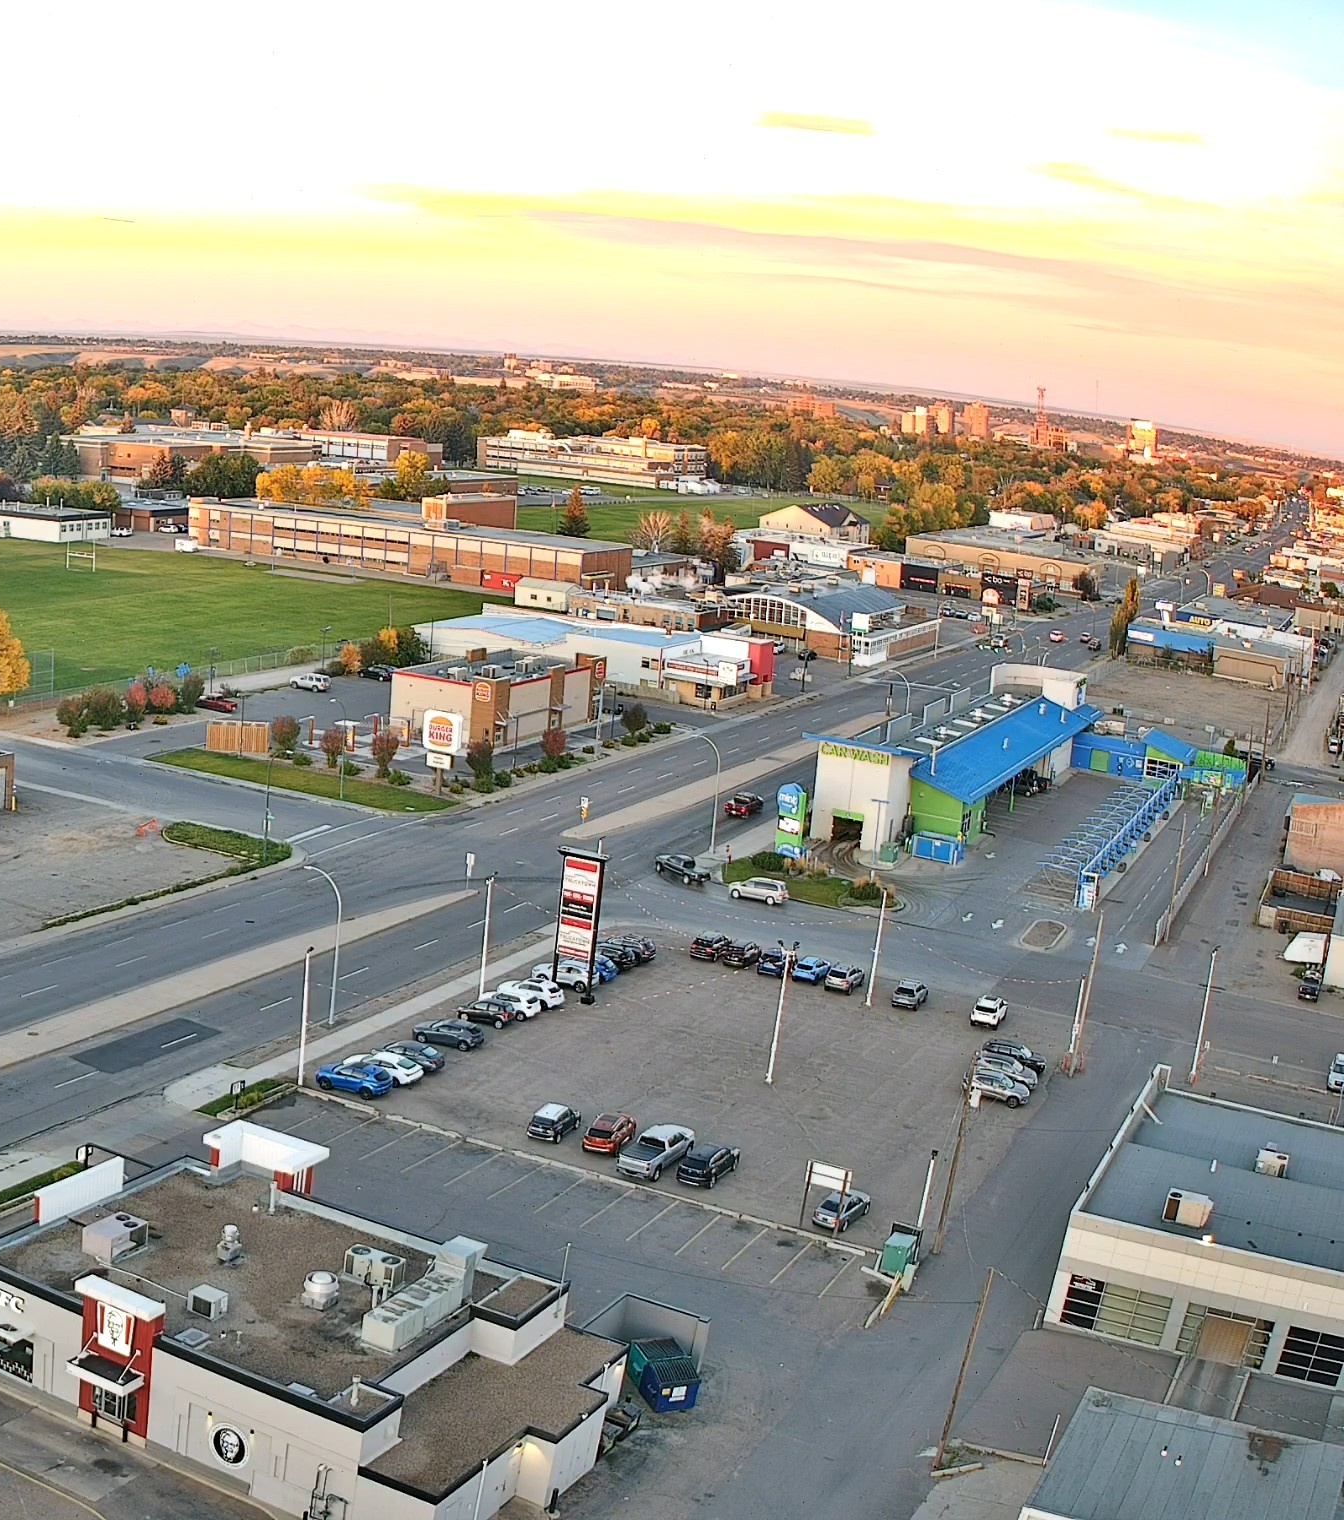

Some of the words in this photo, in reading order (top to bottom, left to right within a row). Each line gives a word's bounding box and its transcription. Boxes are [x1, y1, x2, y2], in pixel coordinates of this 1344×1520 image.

[1188, 615, 1211, 626] AUTO
[428, 723, 453, 734] BURGER
[428, 730, 453, 743] KING
[821, 742, 848, 758] CAR
[850, 748, 890, 766] WASH
